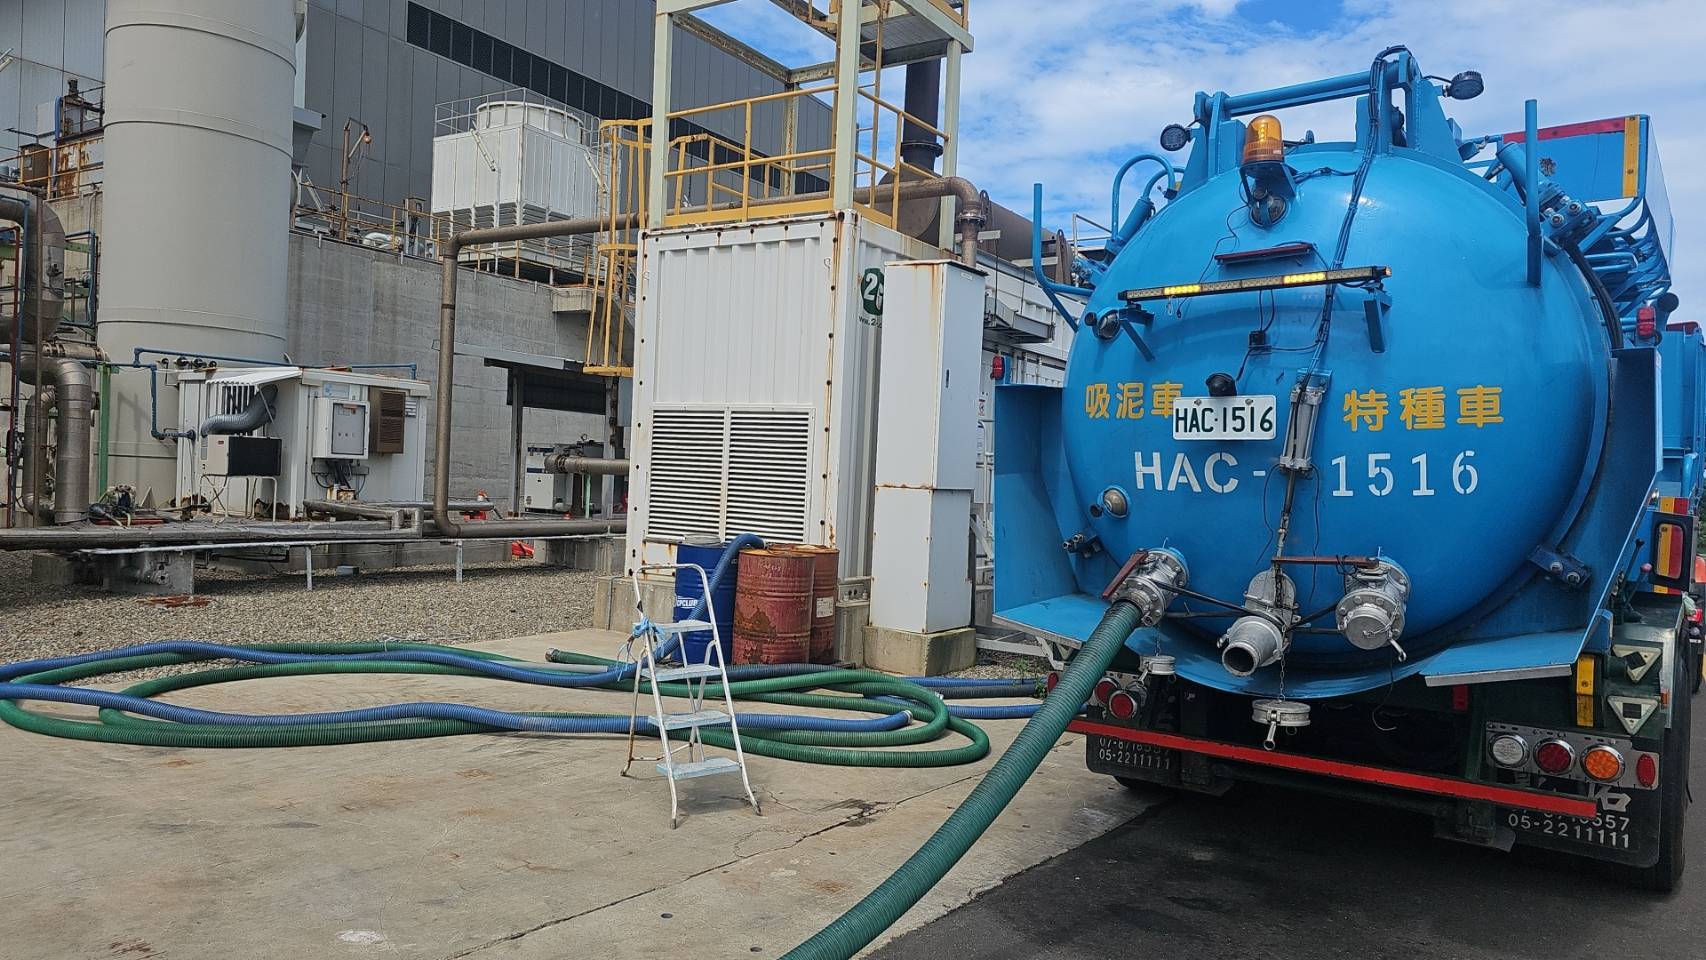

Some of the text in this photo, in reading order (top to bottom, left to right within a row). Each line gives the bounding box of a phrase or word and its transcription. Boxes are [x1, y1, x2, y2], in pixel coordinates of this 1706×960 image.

[1085, 381, 1184, 419] 吸泥車
[1343, 384, 1504, 432] 特種車
[1099, 748, 1170, 769] 05-2211111
[1508, 813, 1630, 849] 05-2211111
